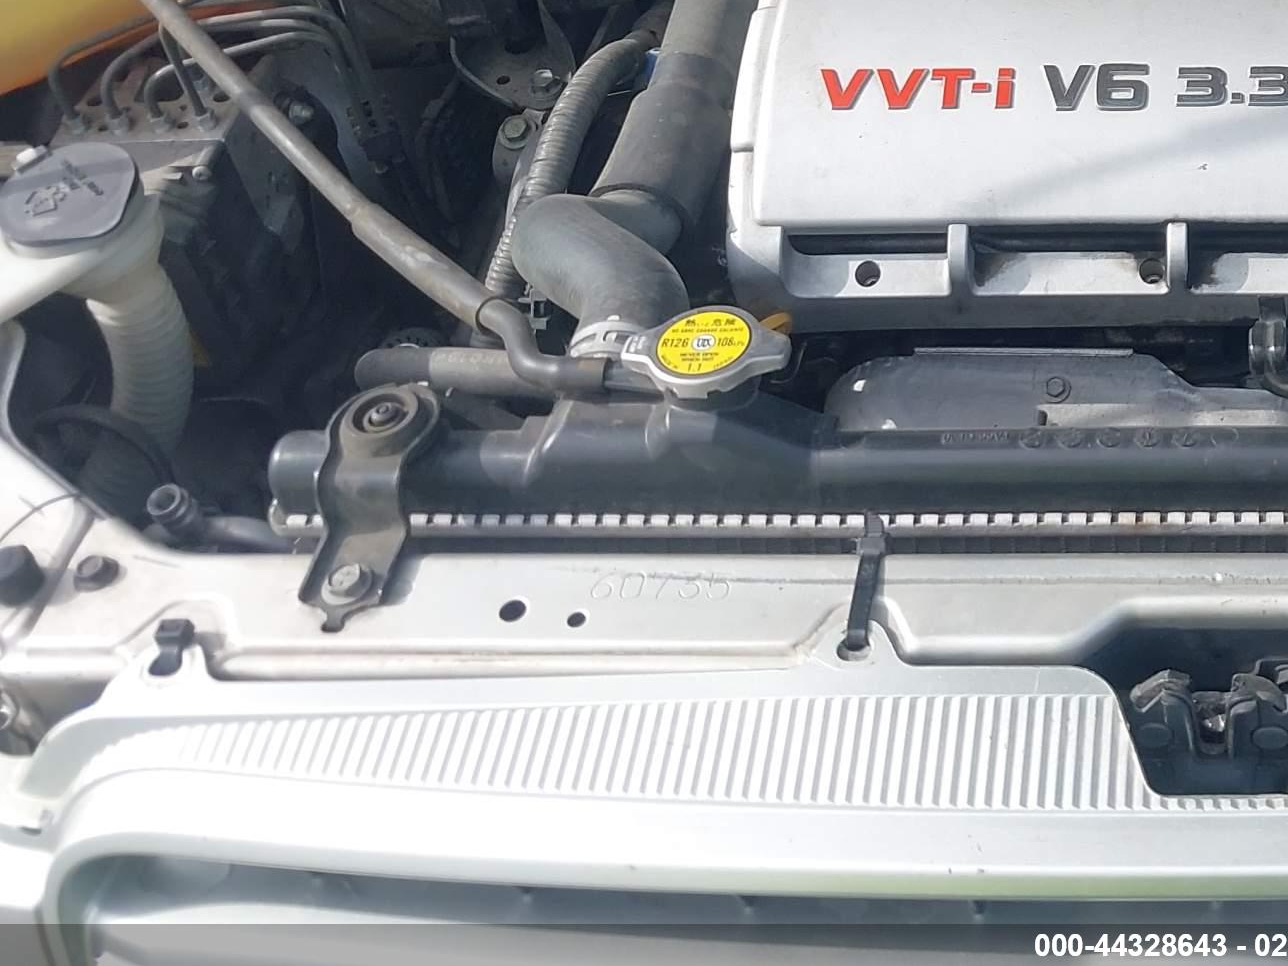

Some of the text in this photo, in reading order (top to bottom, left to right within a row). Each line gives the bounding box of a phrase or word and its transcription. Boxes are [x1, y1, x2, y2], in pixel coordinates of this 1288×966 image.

[820, 67, 1017, 111] VVT-i
[1043, 63, 1150, 111] V6
[661, 337, 690, 348] R126
